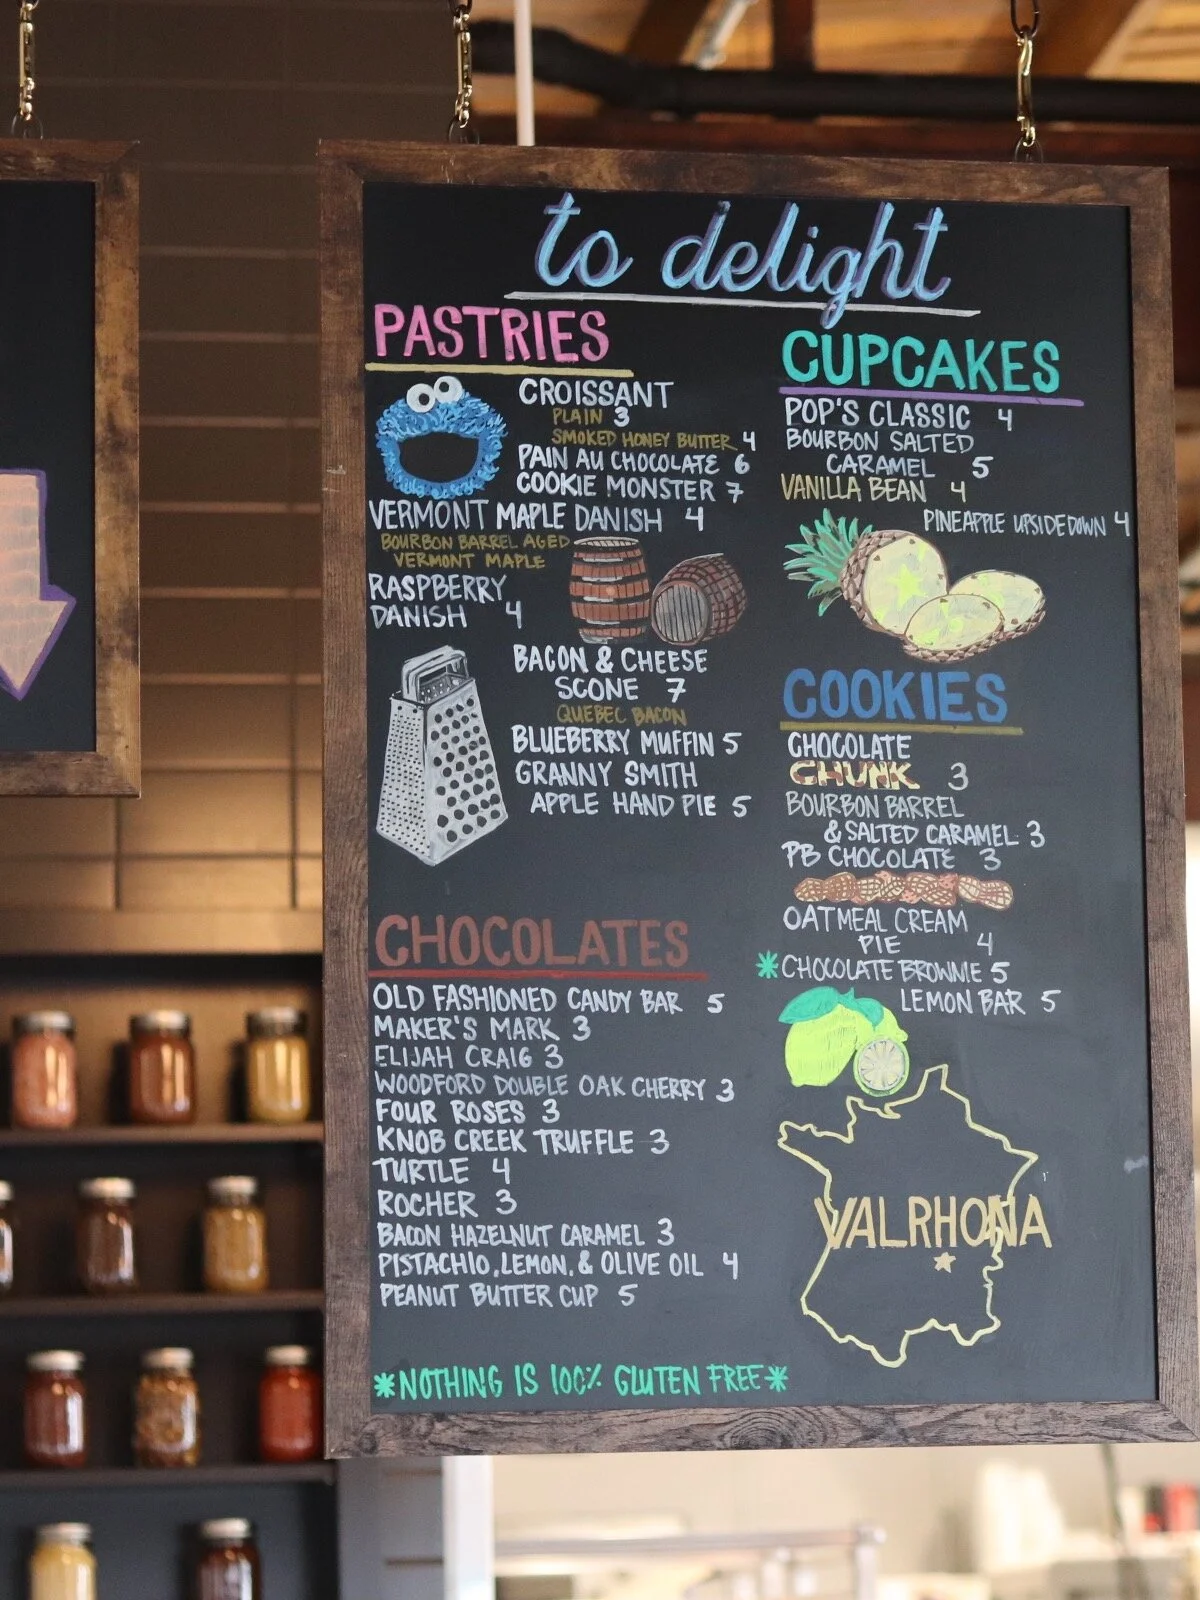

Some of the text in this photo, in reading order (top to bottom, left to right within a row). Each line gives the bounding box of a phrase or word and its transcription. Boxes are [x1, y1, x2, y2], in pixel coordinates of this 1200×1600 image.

[535, 192, 952, 330] to delight
[375, 304, 609, 362] PASTRIES
[782, 330, 1059, 393] CUPCAKES
[519, 378, 674, 408] CROISSANT
[553, 409, 629, 427] PLAIN 3
[785, 398, 1012, 431] POP'S CLASSIC 4
[552, 429, 755, 451] SMOKED HONEY BUTTER 4
[518, 444, 750, 474] PAIN AU CHOCOLATE 6
[517, 472, 743, 501] COOKIE MONSTER 7
[781, 473, 966, 502] VANILLA BEAN 4
[369, 500, 703, 532] VERMONT MAPLE DANISH 4
[381, 533, 570, 550] BOURBON BARREL AGED
[514, 644, 707, 673] BACON & CHEESE
[555, 676, 686, 702] SCONE 7
[783, 668, 1008, 723] COOKIES
[511, 725, 742, 756] BLUEBERRY MUFFIN 5
[788, 732, 911, 760] CHOCOLATE
[789, 760, 968, 790] CHUNK 3
[782, 841, 1001, 871] PB CHOCOLATE 3
[375, 914, 688, 967] CHOCOLATES
[373, 983, 725, 1014] OLD FASHIONED CANDY BAR 5
[901, 989, 1061, 1016] LEMON BAR 5
[374, 1015, 591, 1041] MAKER'S MARK 3
[376, 1099, 560, 1124] FOUR ROSES 3
[376, 1125, 669, 1155] KNOB CREEK TRUFFLE 3
[814, 1195, 1052, 1249] VALRHONA
[380, 1283, 638, 1308] PEANUT BUTTER CUP 5
[400, 1363, 765, 1400] NOTHING IS 100% GLUTEN FREE
